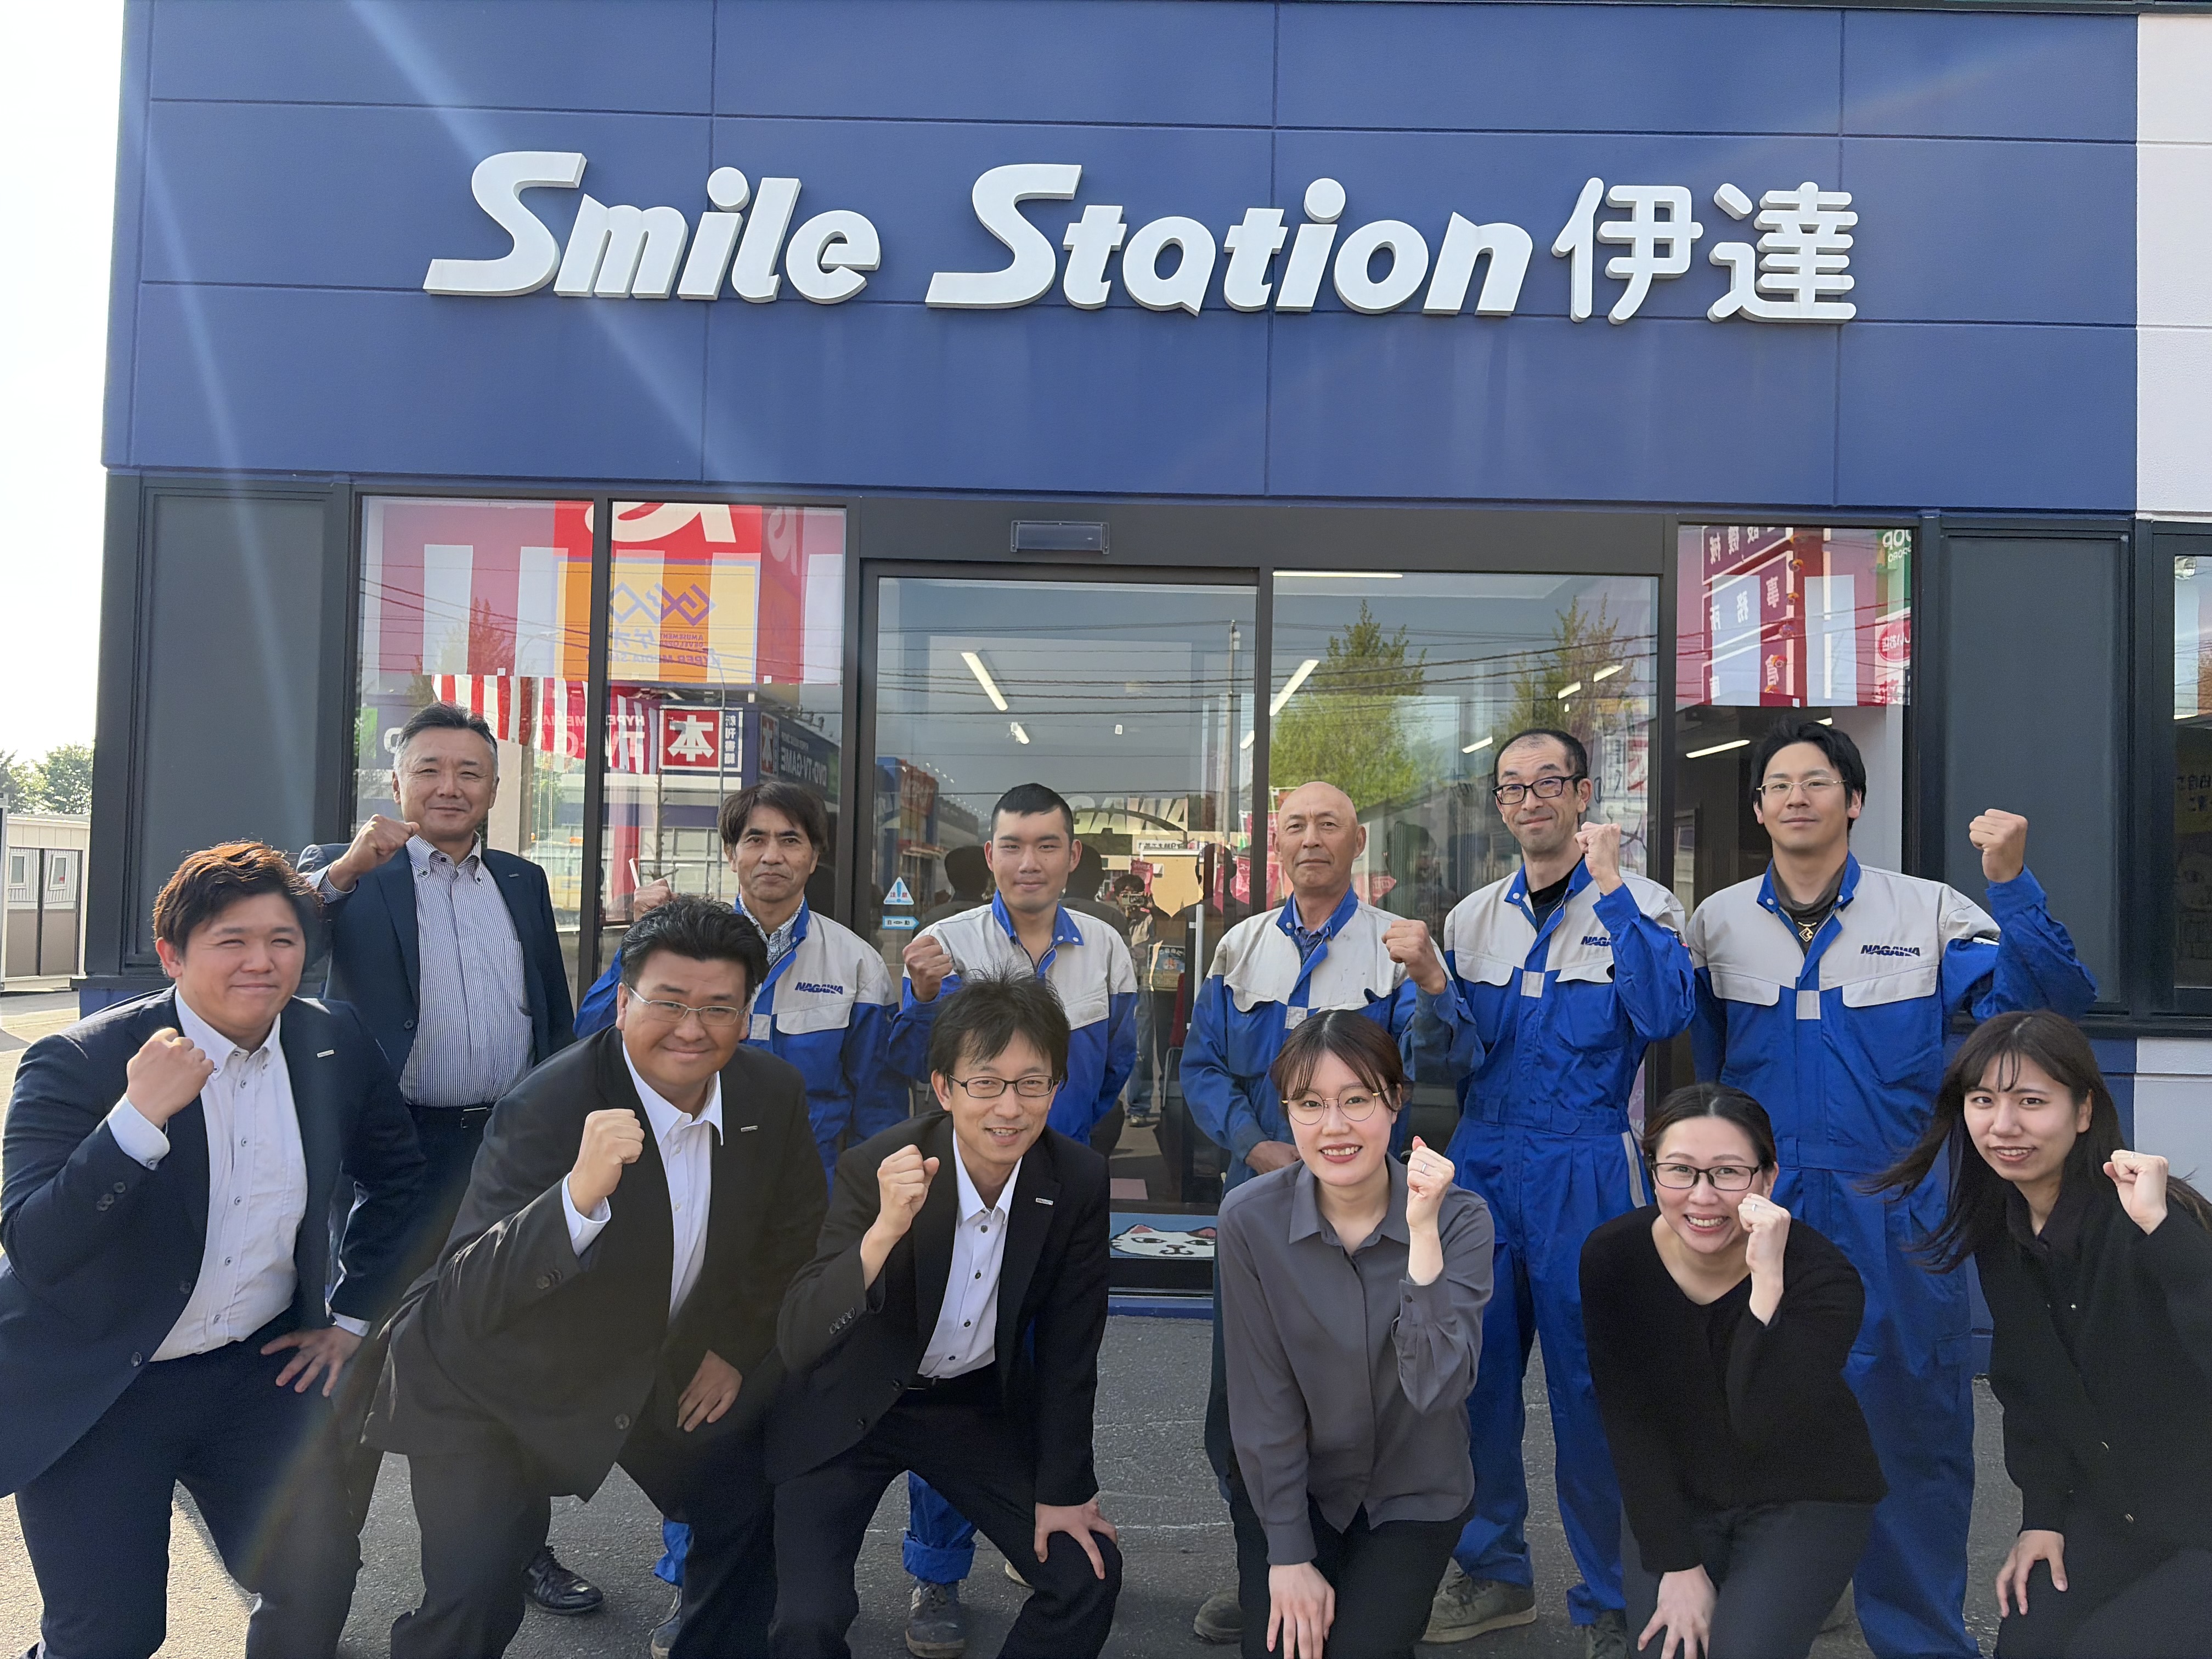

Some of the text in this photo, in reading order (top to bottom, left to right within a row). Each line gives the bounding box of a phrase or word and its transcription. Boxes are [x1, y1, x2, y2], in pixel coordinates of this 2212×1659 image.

[423, 151, 1858, 325] Smile Station 伊達
[1860, 944, 1920, 956] NAGAWA
[794, 982, 843, 995] NAGAWA
